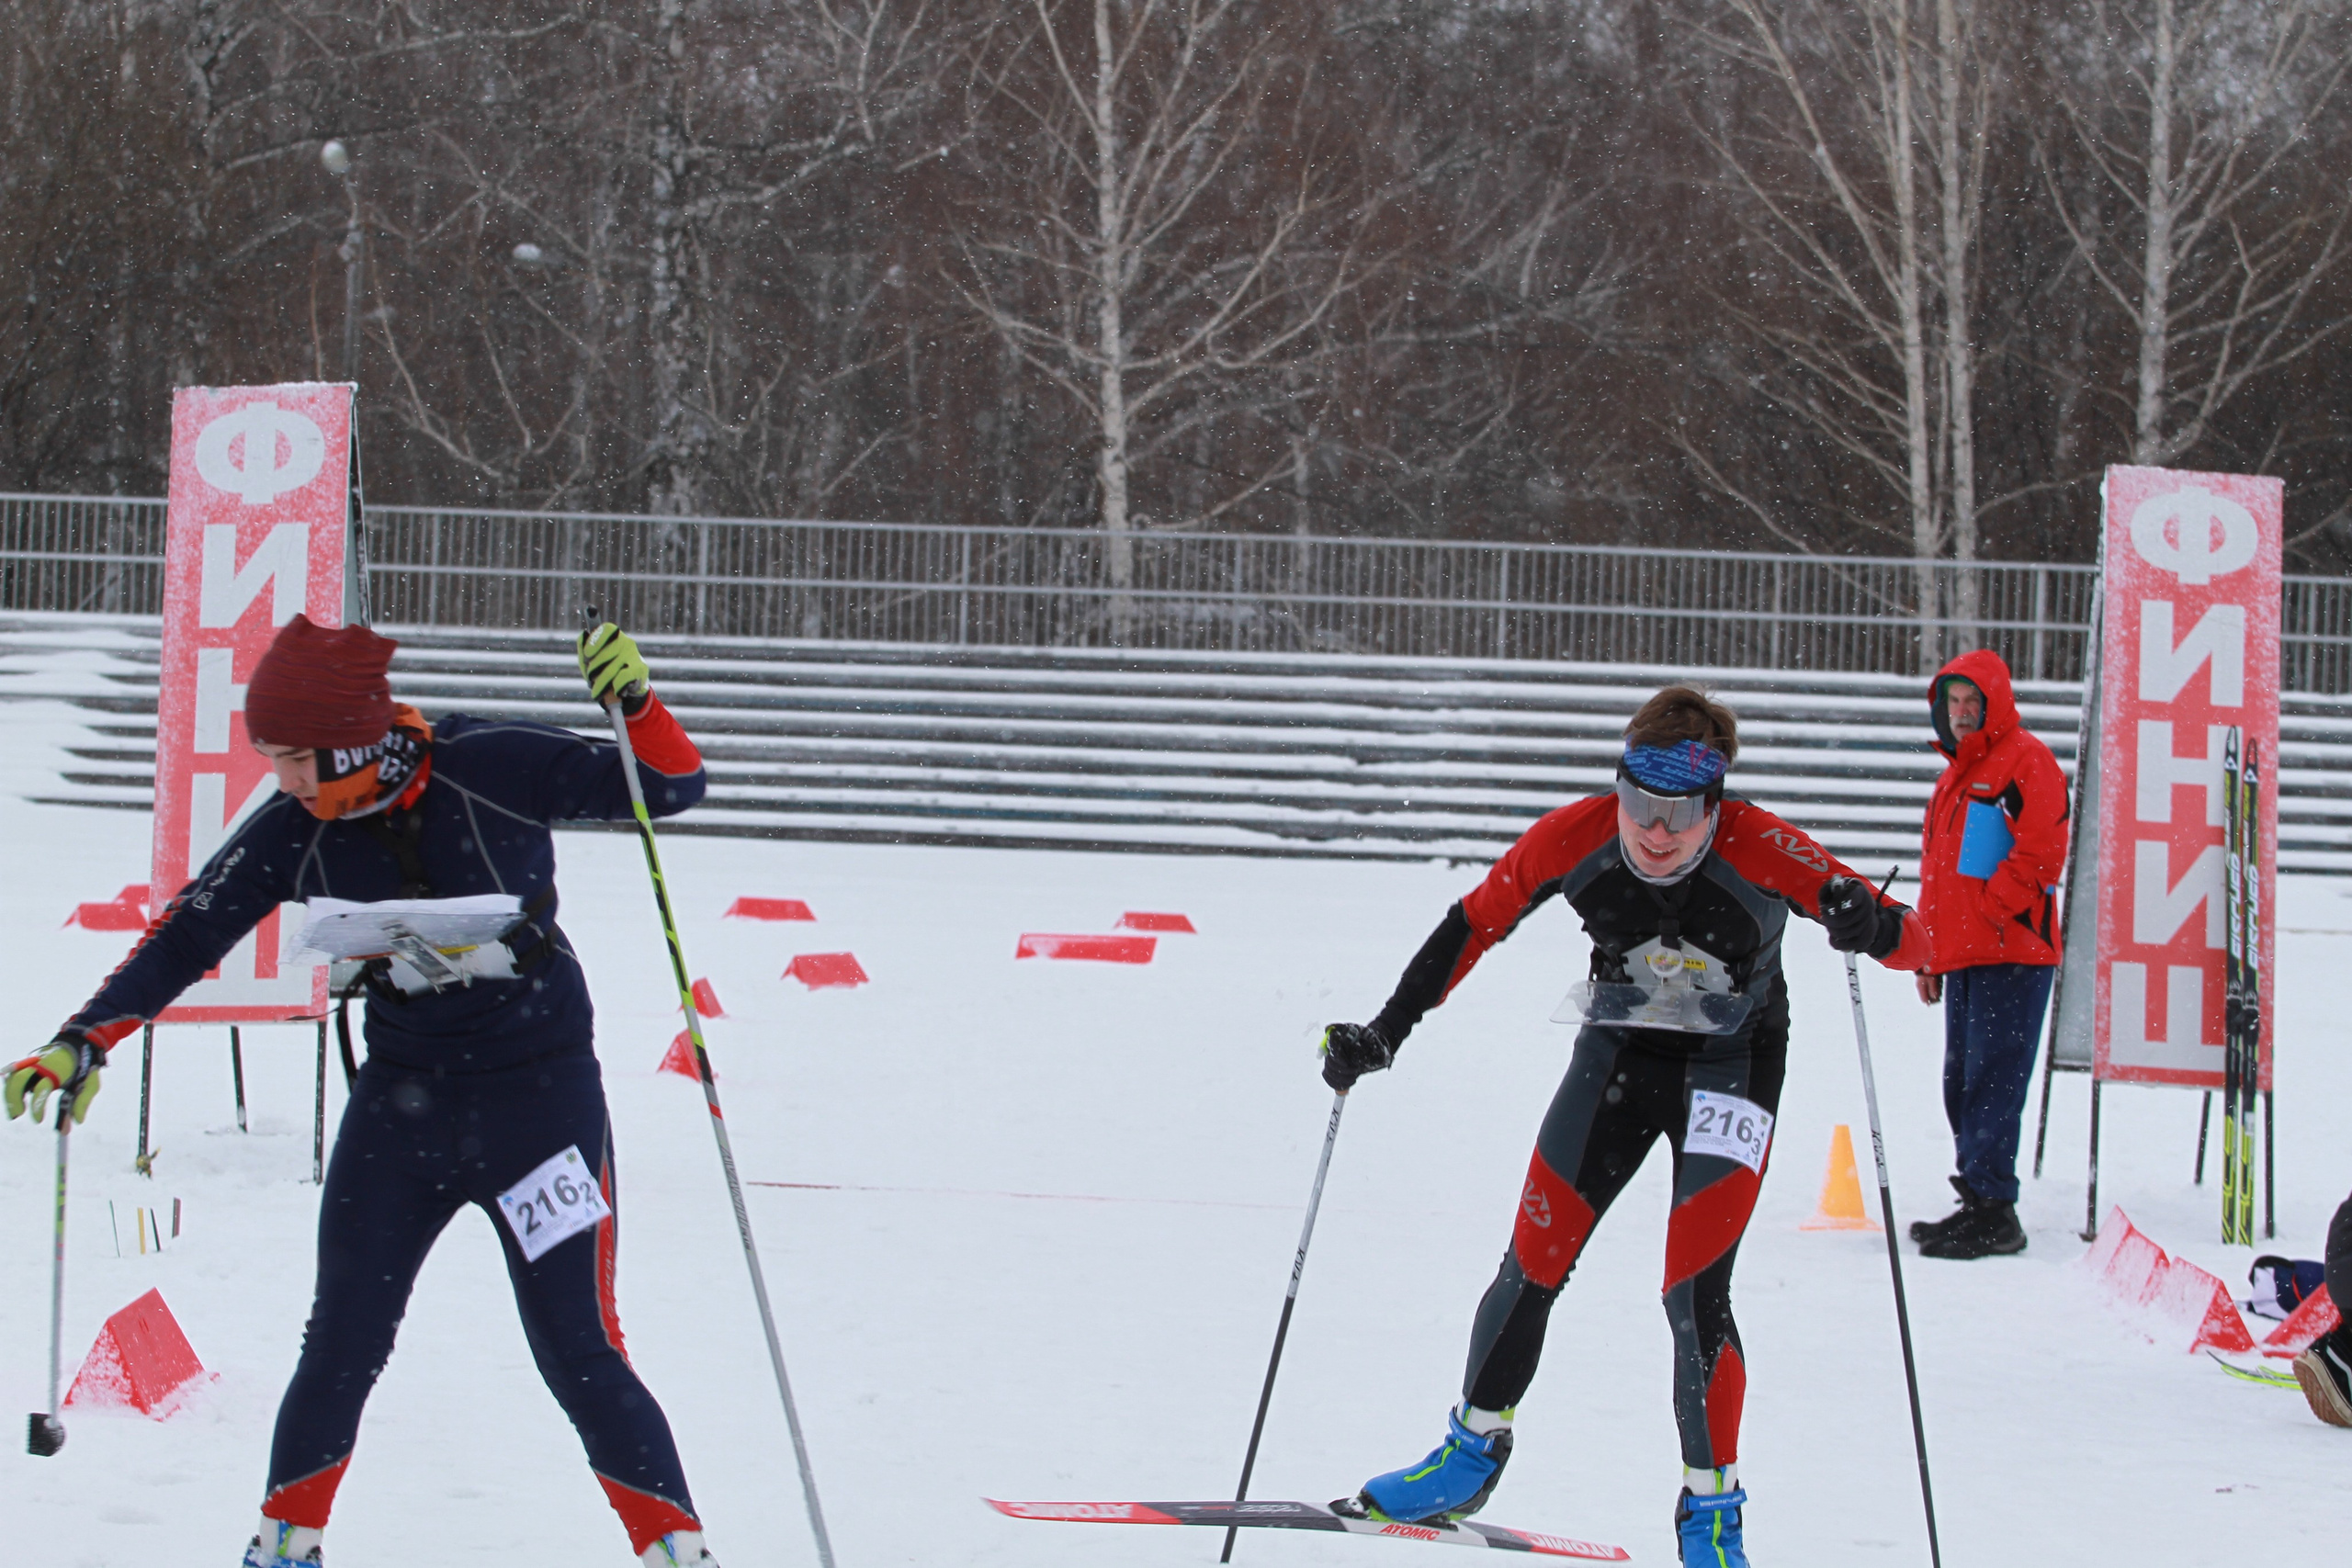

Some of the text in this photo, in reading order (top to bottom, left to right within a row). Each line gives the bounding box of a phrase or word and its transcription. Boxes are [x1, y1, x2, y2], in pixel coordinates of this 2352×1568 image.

[2109, 486, 2258, 1075] ФИНИШ
[1693, 1106, 1755, 1144] 216
[517, 1174, 580, 1236] 216
[1008, 1502, 1134, 1517] ATOMIC
[1380, 1523, 1441, 1541] ATOMIC
[1526, 1533, 1615, 1558] ATOMIC
